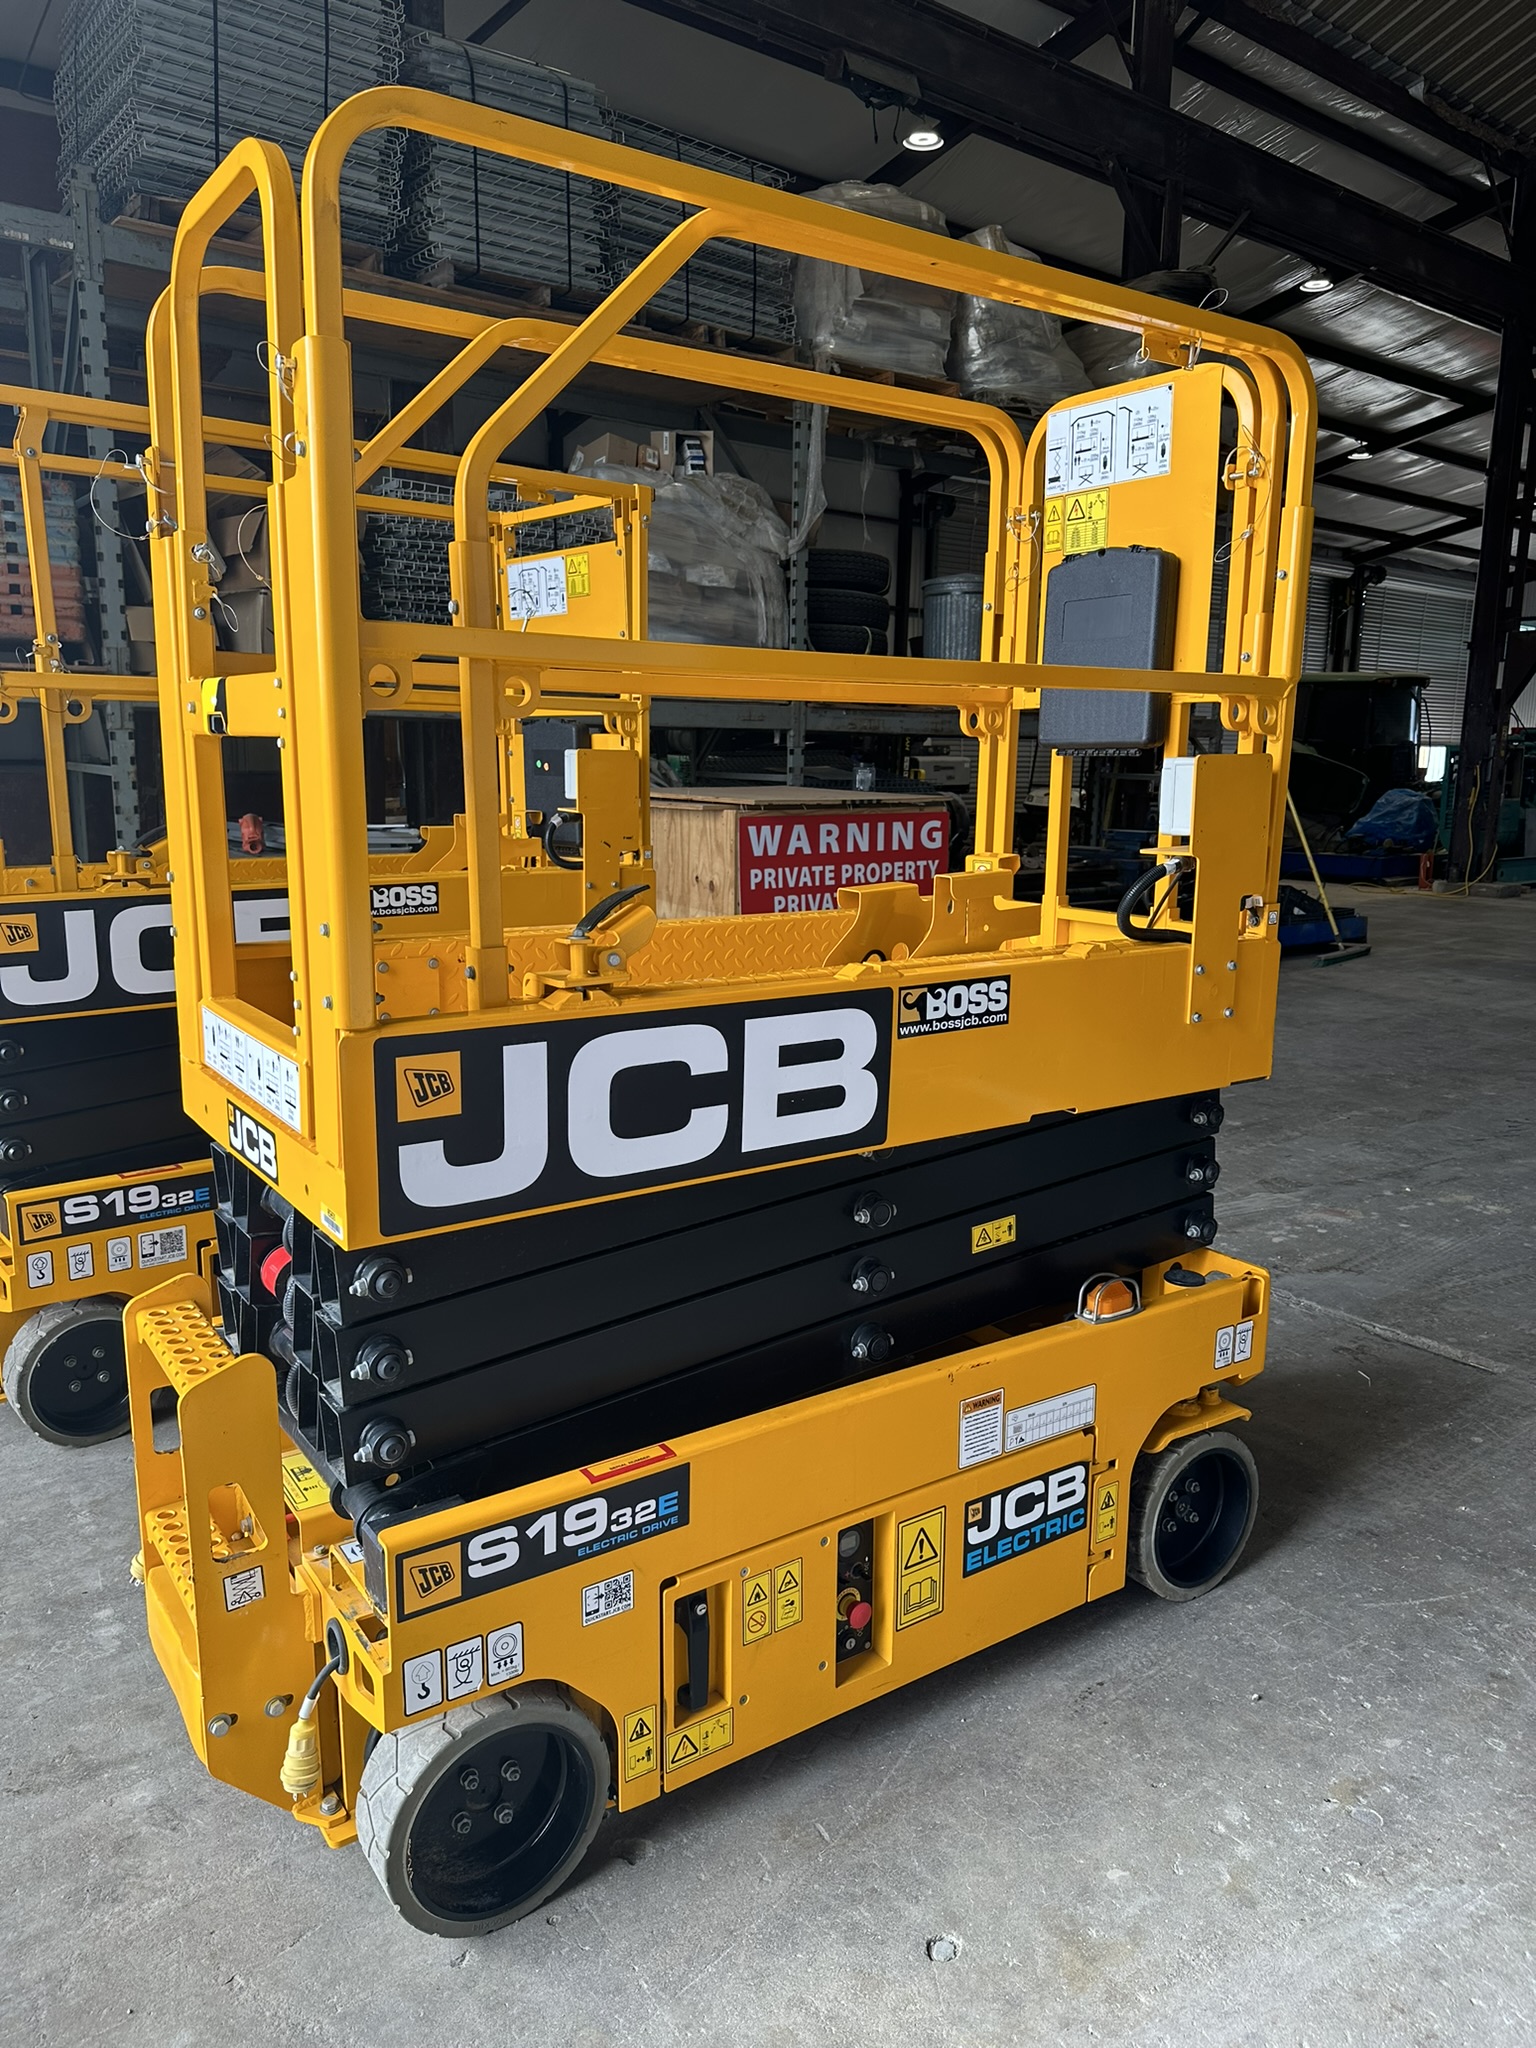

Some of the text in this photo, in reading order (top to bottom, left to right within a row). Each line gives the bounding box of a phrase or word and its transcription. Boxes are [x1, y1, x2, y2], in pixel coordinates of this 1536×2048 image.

[748, 820, 943, 857] WARNING
[750, 860, 940, 890] PRIVATE PROPERTY
[373, 884, 438, 908] BOSS
[774, 892, 838, 913] PRIVA
[6, 924, 32, 943] JCB
[926, 980, 1008, 1020] BOSS
[900, 1013, 1007, 1036] www.bossjcb.com
[412, 1070, 455, 1105] JCB
[399, 1008, 878, 1207] JCB
[229, 1109, 277, 1179] JCB
[31, 1212, 54, 1231] JCB
[139, 1202, 210, 1220] ELECTRIC DRIVE
[973, 1394, 1001, 1408] WARNING
[967, 1465, 1086, 1545] JCB
[577, 1515, 679, 1557] ELECTRIC DRIVE
[967, 1508, 1085, 1572] ELECTRIC
[417, 1563, 453, 1594] JCB
